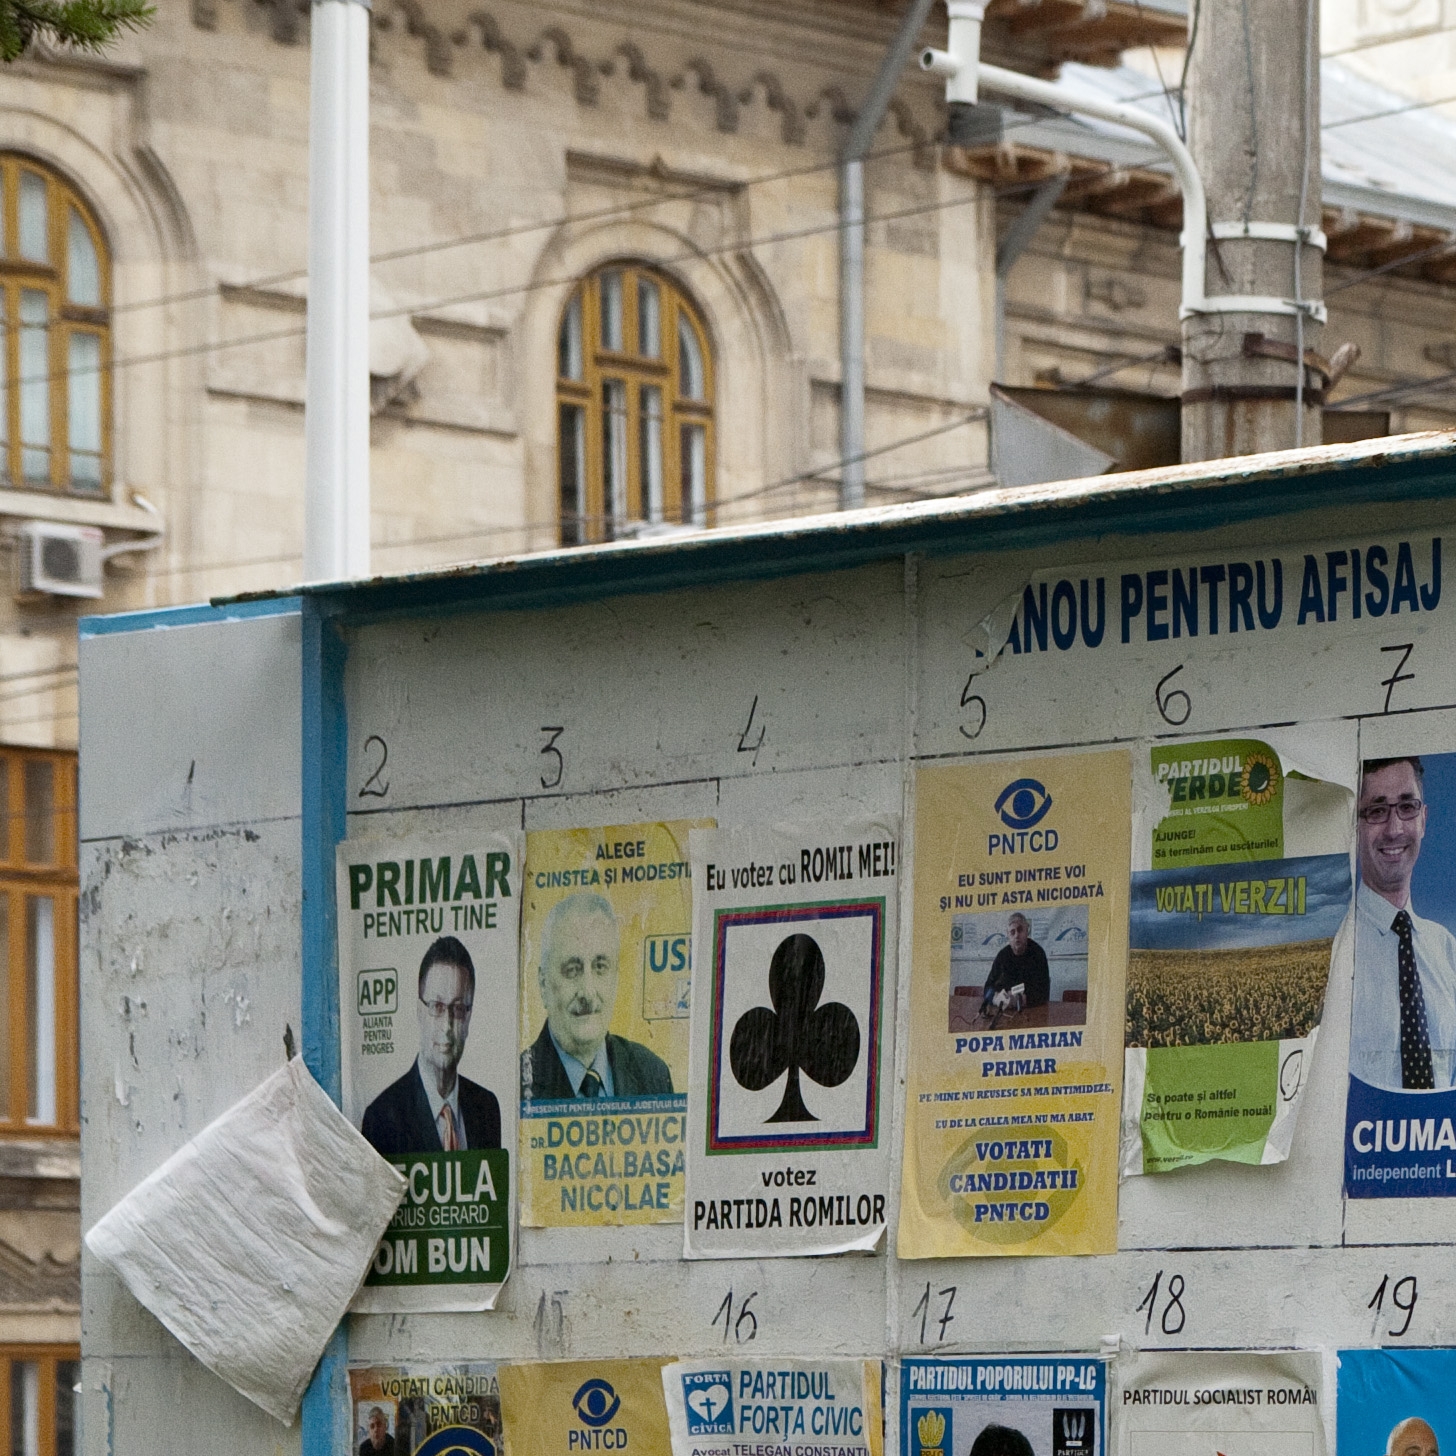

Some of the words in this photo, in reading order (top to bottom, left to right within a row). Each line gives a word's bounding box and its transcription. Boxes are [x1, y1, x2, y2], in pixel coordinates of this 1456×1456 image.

[1004, 576, 1106, 656] ANOU
[1121, 557, 1283, 644] PENTRU
[1297, 537, 1442, 625] AFISAJ
[1156, 664, 1191, 726] 6
[1380, 643, 1415, 714] 7
[959, 673, 986, 739] 5
[737, 695, 766, 767] 4
[359, 735, 389, 797] 2
[541, 726, 564, 789] 3
[1158, 756, 1243, 780] PARTIDUL
[596, 841, 645, 860] ALEGE
[988, 829, 1058, 855] PNTCD
[349, 852, 512, 910] PRIMAR
[536, 870, 599, 889] CINSTEA
[706, 864, 725, 891] Eu
[731, 861, 773, 889] votez
[778, 860, 796, 885] cu
[801, 846, 852, 882] ROMII
[859, 841, 895, 877] MEI!
[958, 873, 976, 888] EU
[979, 869, 1009, 886] SUNT
[1014, 866, 1060, 884] DINTRE
[1064, 865, 1085, 879] VOI
[1156, 885, 1213, 922] VOTAȚI
[1219, 876, 1307, 915] VERZII
[363, 906, 444, 938] PENTRU
[452, 902, 497, 932] TINE
[360, 977, 396, 1006] APP
[1147, 1093, 1161, 1103] Se
[1164, 1093, 1194, 1105] poate
[1209, 1089, 1236, 1100] altfel
[762, 1166, 816, 1187] votez
[1353, 1163, 1441, 1181] independent
[429, 1205, 489, 1224] GERARD
[561, 1183, 670, 1212] NICOLAE
[695, 1197, 782, 1230] PARTIDA
[790, 1194, 885, 1227] ROMILOR
[429, 1237, 490, 1272] BUN
[711, 1287, 757, 1344] 16
[912, 1281, 957, 1343] 17
[1136, 1270, 1186, 1335] 18
[1368, 1274, 1417, 1337] 19
[739, 1371, 835, 1400] PARTIDUL
[909, 1365, 974, 1390] PARTIDUL
[977, 1365, 1052, 1391] POPORULUI
[1056, 1364, 1096, 1388] PP-LC
[1124, 1388, 1190, 1405] PARTIDUL
[1193, 1388, 1262, 1405] SOCIALIST
[1267, 1386, 1317, 1405] ROMÂN
[569, 1428, 628, 1451] PNTCD
[740, 1405, 805, 1442] FORȚA
[812, 1406, 863, 1435] CIVIC
[692, 1447, 730, 1456] Avocat
